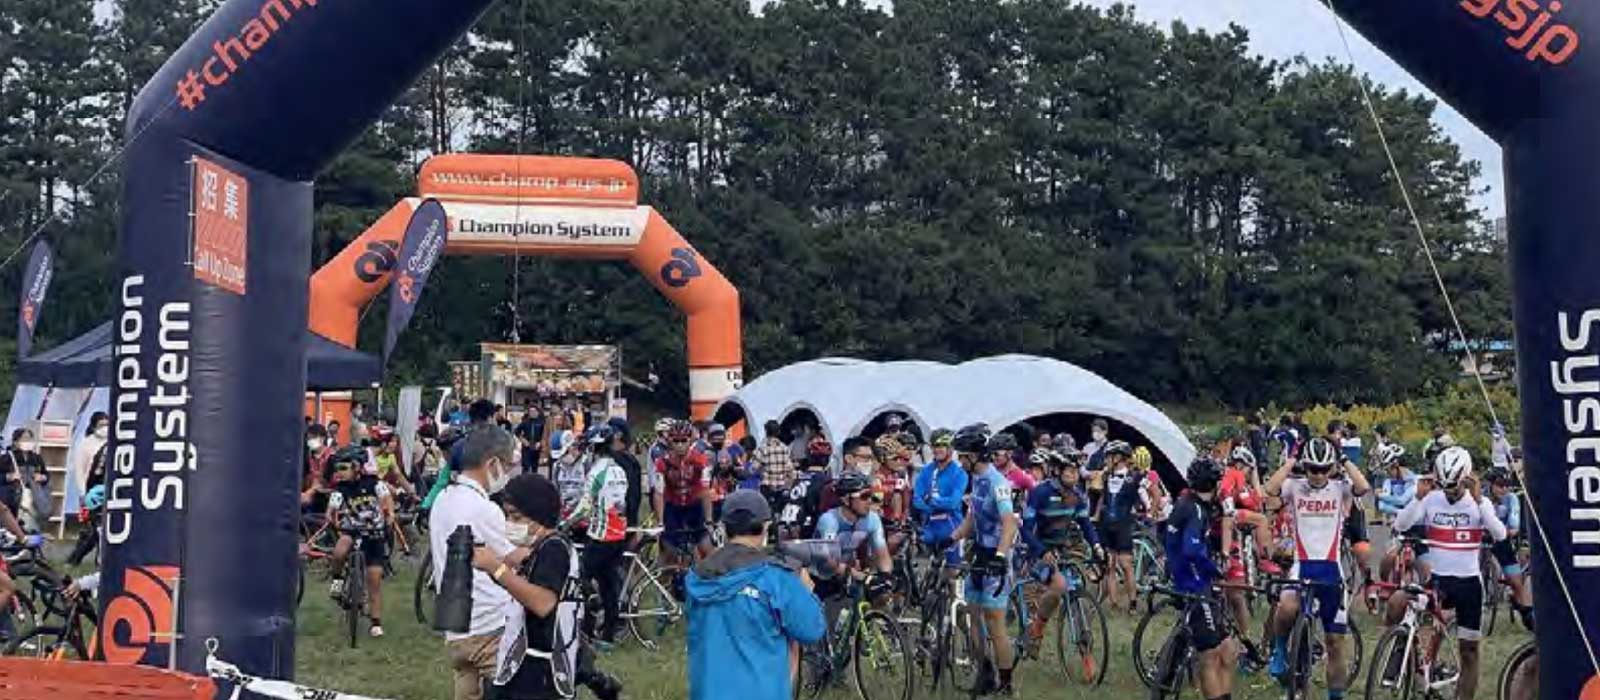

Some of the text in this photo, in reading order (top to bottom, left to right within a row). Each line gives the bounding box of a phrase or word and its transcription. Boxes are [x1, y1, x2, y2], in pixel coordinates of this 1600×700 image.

[176, 0, 317, 110] #cham
[460, 219, 630, 238] Champion System
[106, 274, 148, 544] Champion
[141, 302, 198, 510] System
[1551, 309, 1600, 568] System
[1297, 499, 1338, 511] PEDAL
